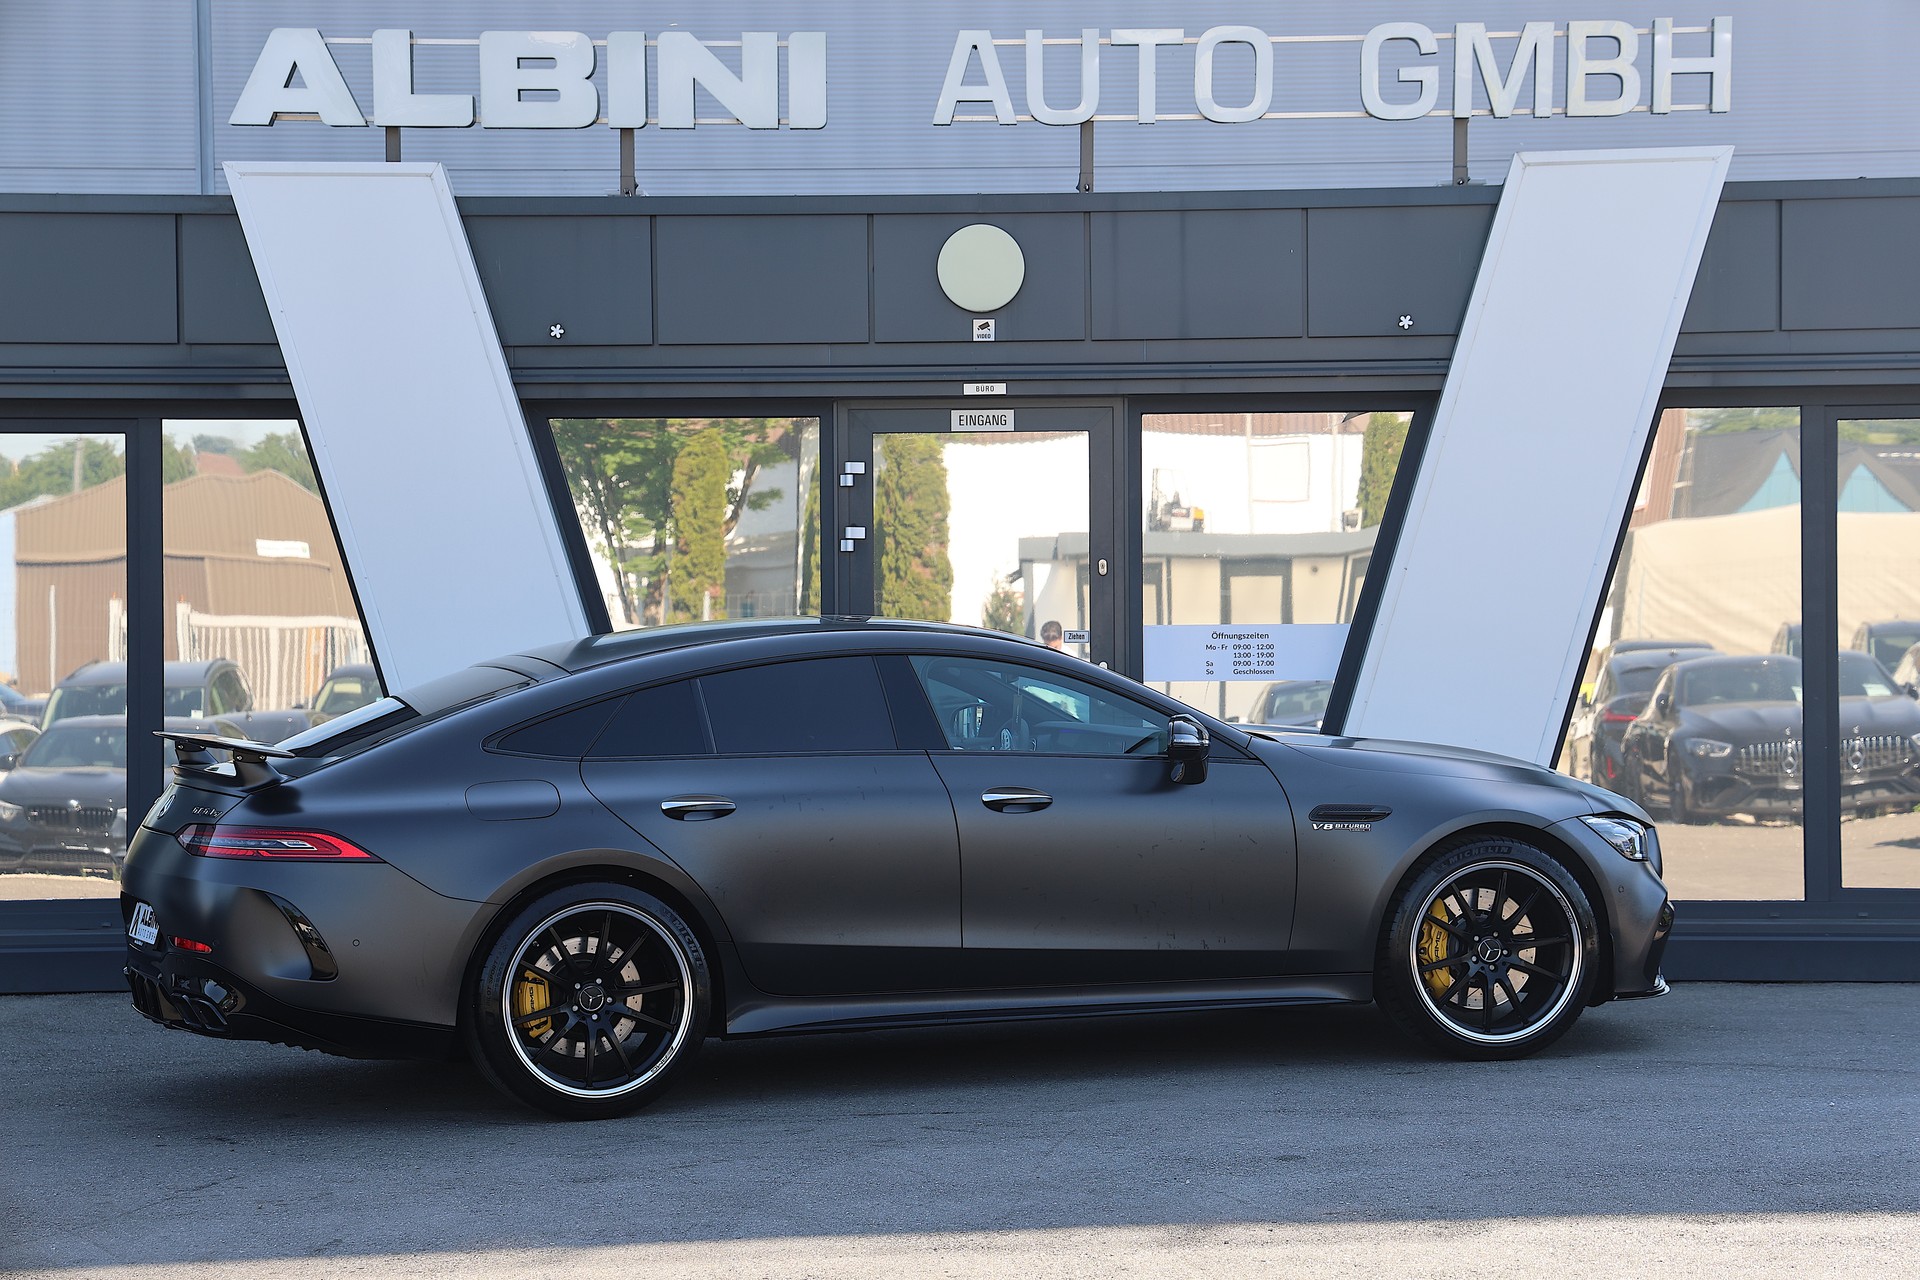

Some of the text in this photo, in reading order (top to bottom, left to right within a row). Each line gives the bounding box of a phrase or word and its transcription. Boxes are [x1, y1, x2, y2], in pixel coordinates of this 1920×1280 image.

[229, 16, 1734, 130] ALBINI AUTO GMBH
[958, 414, 1007, 426] EINGANG
[1068, 632, 1085, 640] Ziehen
[1211, 631, 1270, 640] Öffnungszeiten
[1312, 823, 1334, 831] V8
[1448, 845, 1510, 865] MICHELIN
